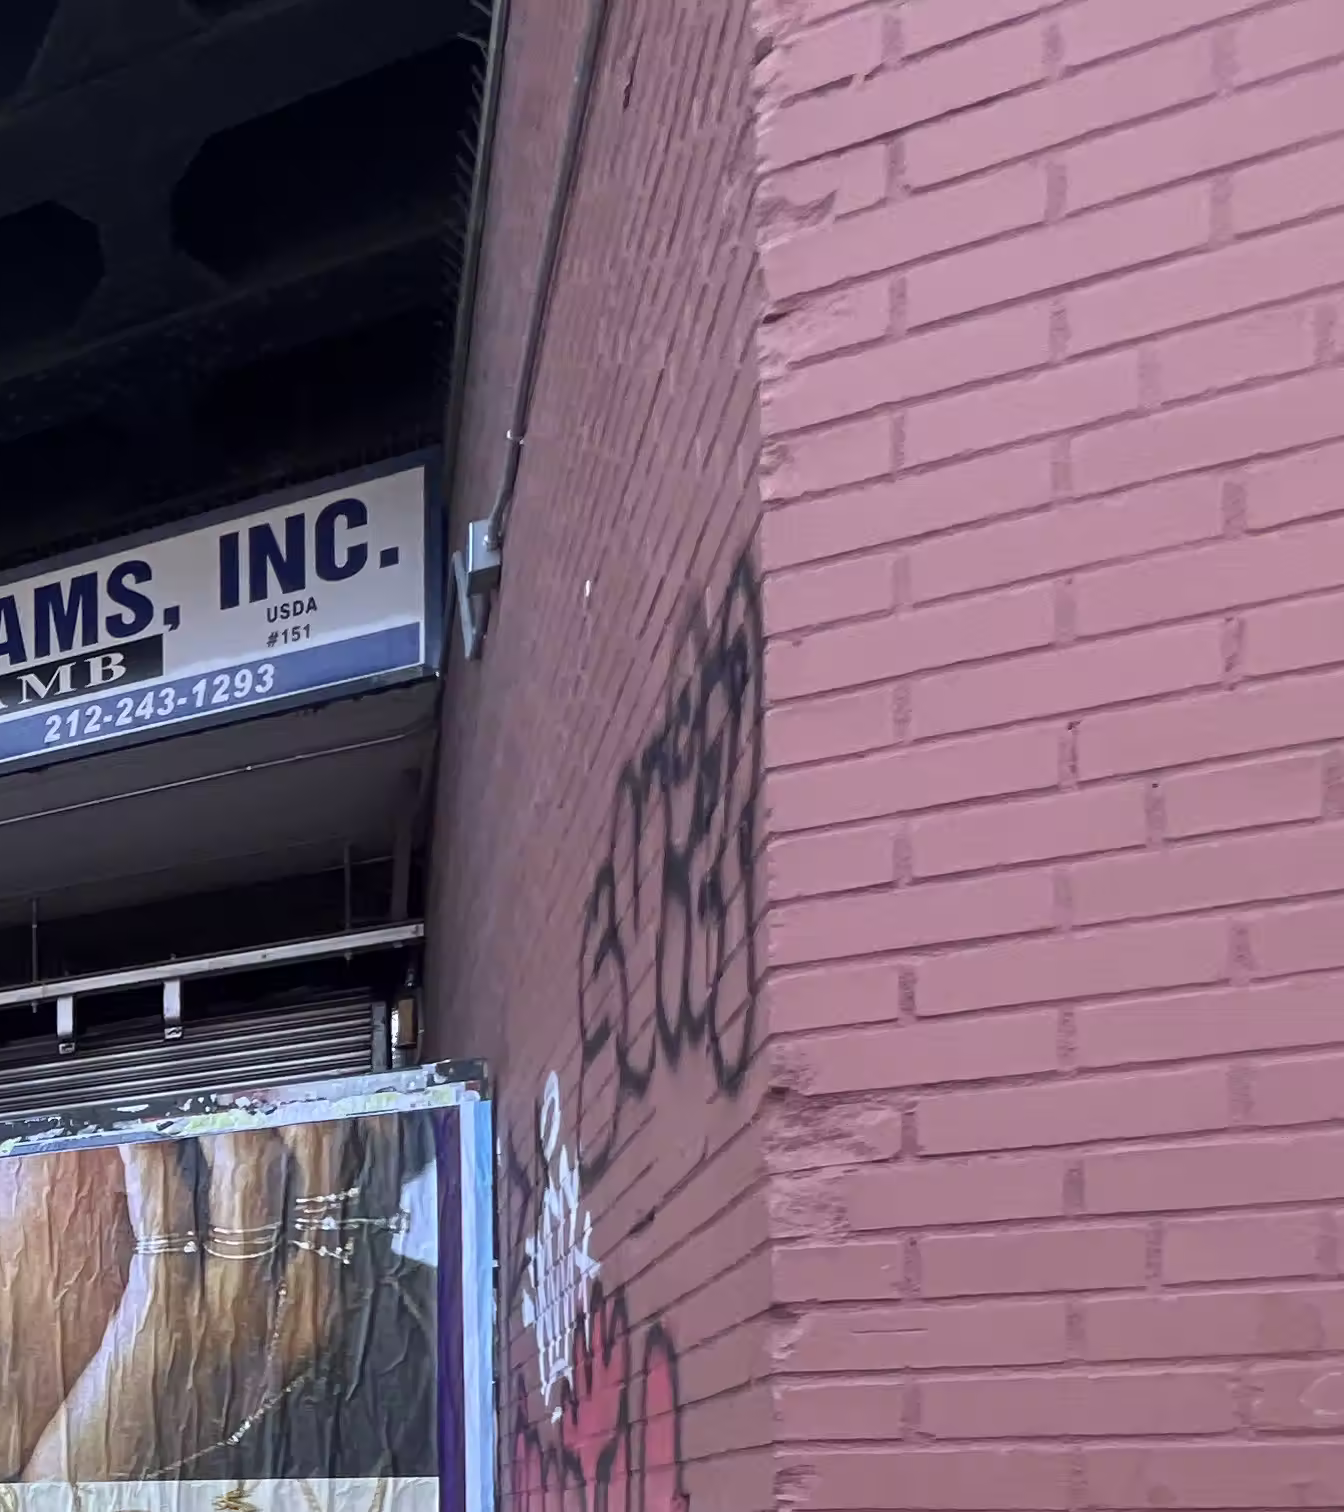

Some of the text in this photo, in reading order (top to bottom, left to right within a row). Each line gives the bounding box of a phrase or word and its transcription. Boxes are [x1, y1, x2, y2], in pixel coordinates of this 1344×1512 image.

[219, 498, 400, 611] INC.
[265, 596, 318, 624] USDA
[265, 623, 312, 648] #151
[43, 663, 276, 744] 212-243-1293
